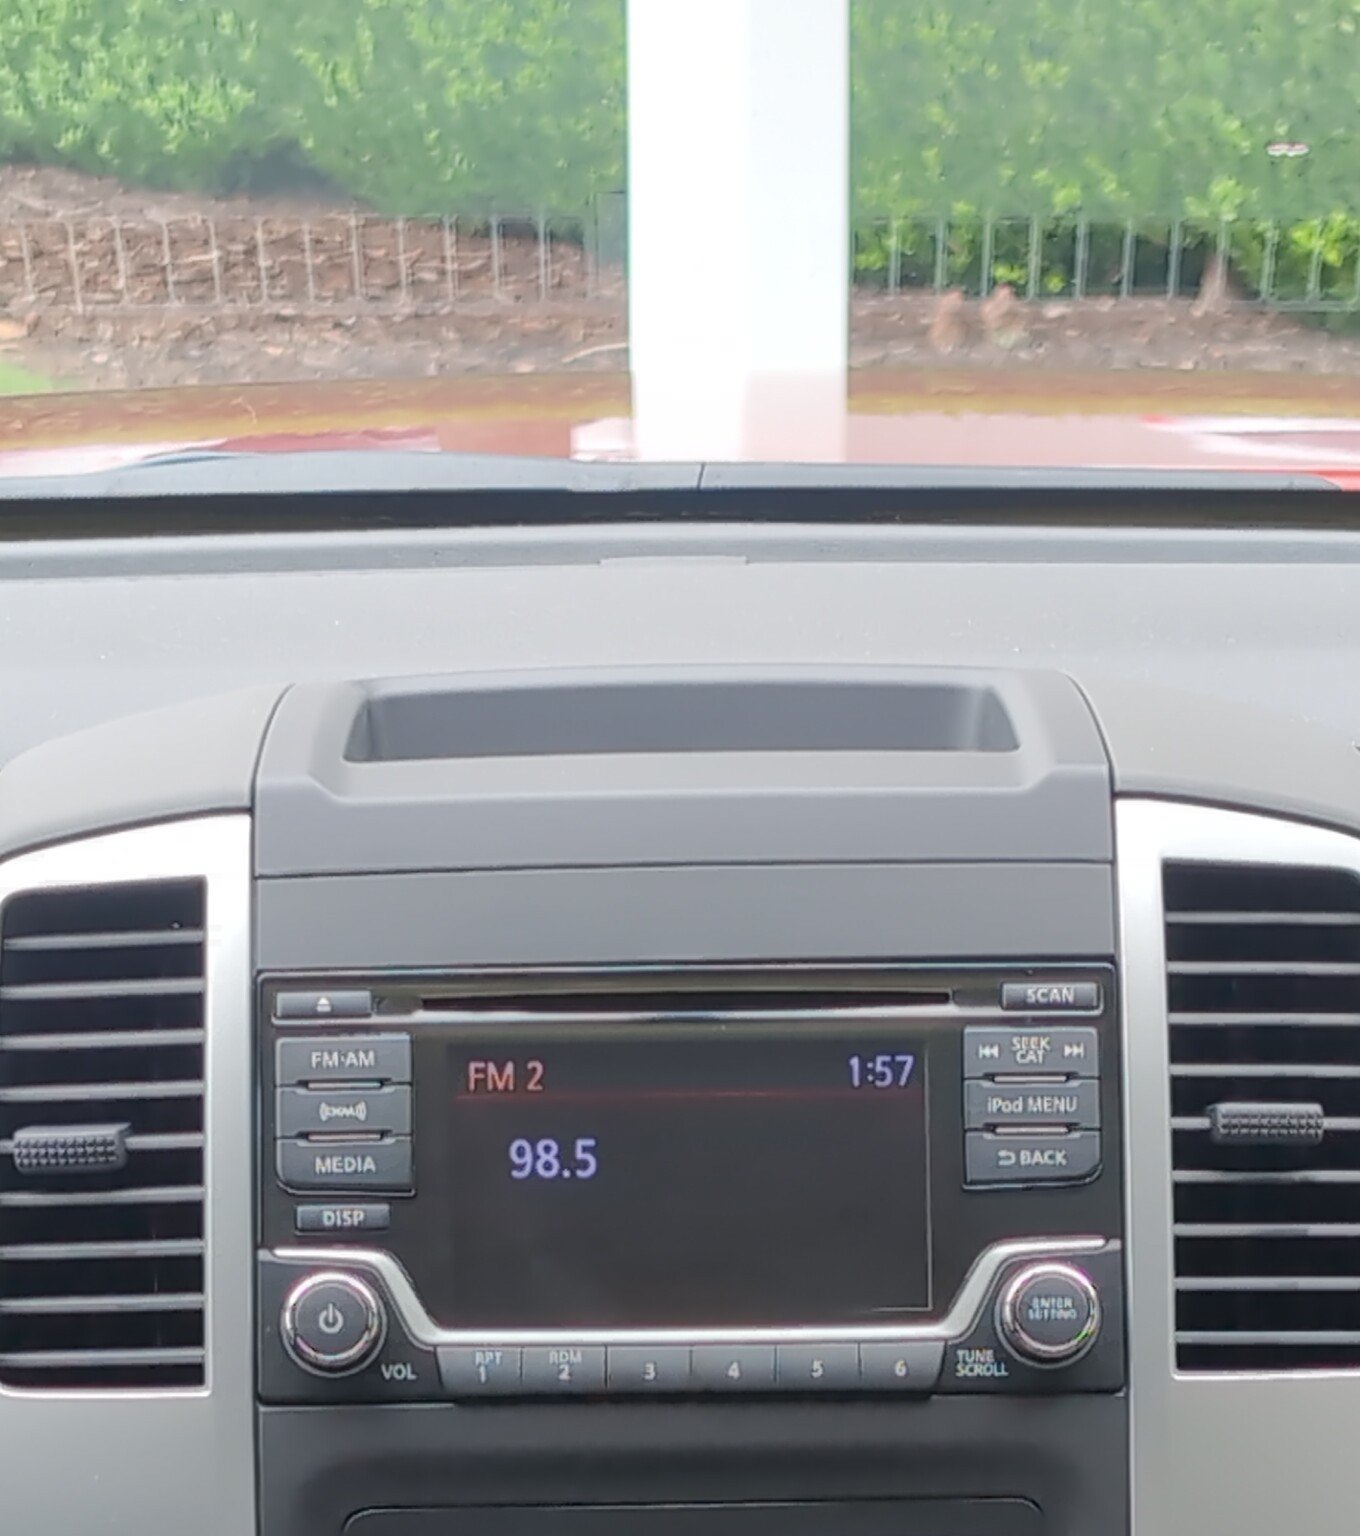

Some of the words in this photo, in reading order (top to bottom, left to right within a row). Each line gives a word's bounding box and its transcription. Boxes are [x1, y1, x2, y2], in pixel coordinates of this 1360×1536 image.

[1026, 987, 1074, 1003] SCAN
[1011, 1036, 1051, 1051] SEEK
[467, 1062, 514, 1091] FM
[527, 1062, 544, 1091] 2
[847, 1055, 915, 1088] 1:57
[987, 1097, 1023, 1114] iPod
[1027, 1096, 1078, 1113] MENU
[315, 1155, 376, 1174] MEDIA
[509, 1138, 598, 1179] 98.5
[1020, 1150, 1068, 1165] BACK
[322, 1210, 365, 1227] DISP
[475, 1351, 503, 1366] RPT
[957, 1349, 995, 1363] TUNE
[381, 1365, 417, 1380] VOL
[478, 1365, 487, 1383] 1
[558, 1364, 571, 1381] 2
[643, 1364, 655, 1379] 3
[728, 1361, 739, 1378] 4
[812, 1361, 823, 1377] 5
[895, 1361, 907, 1377] 6
[955, 1362, 1008, 1377] SCROLL
